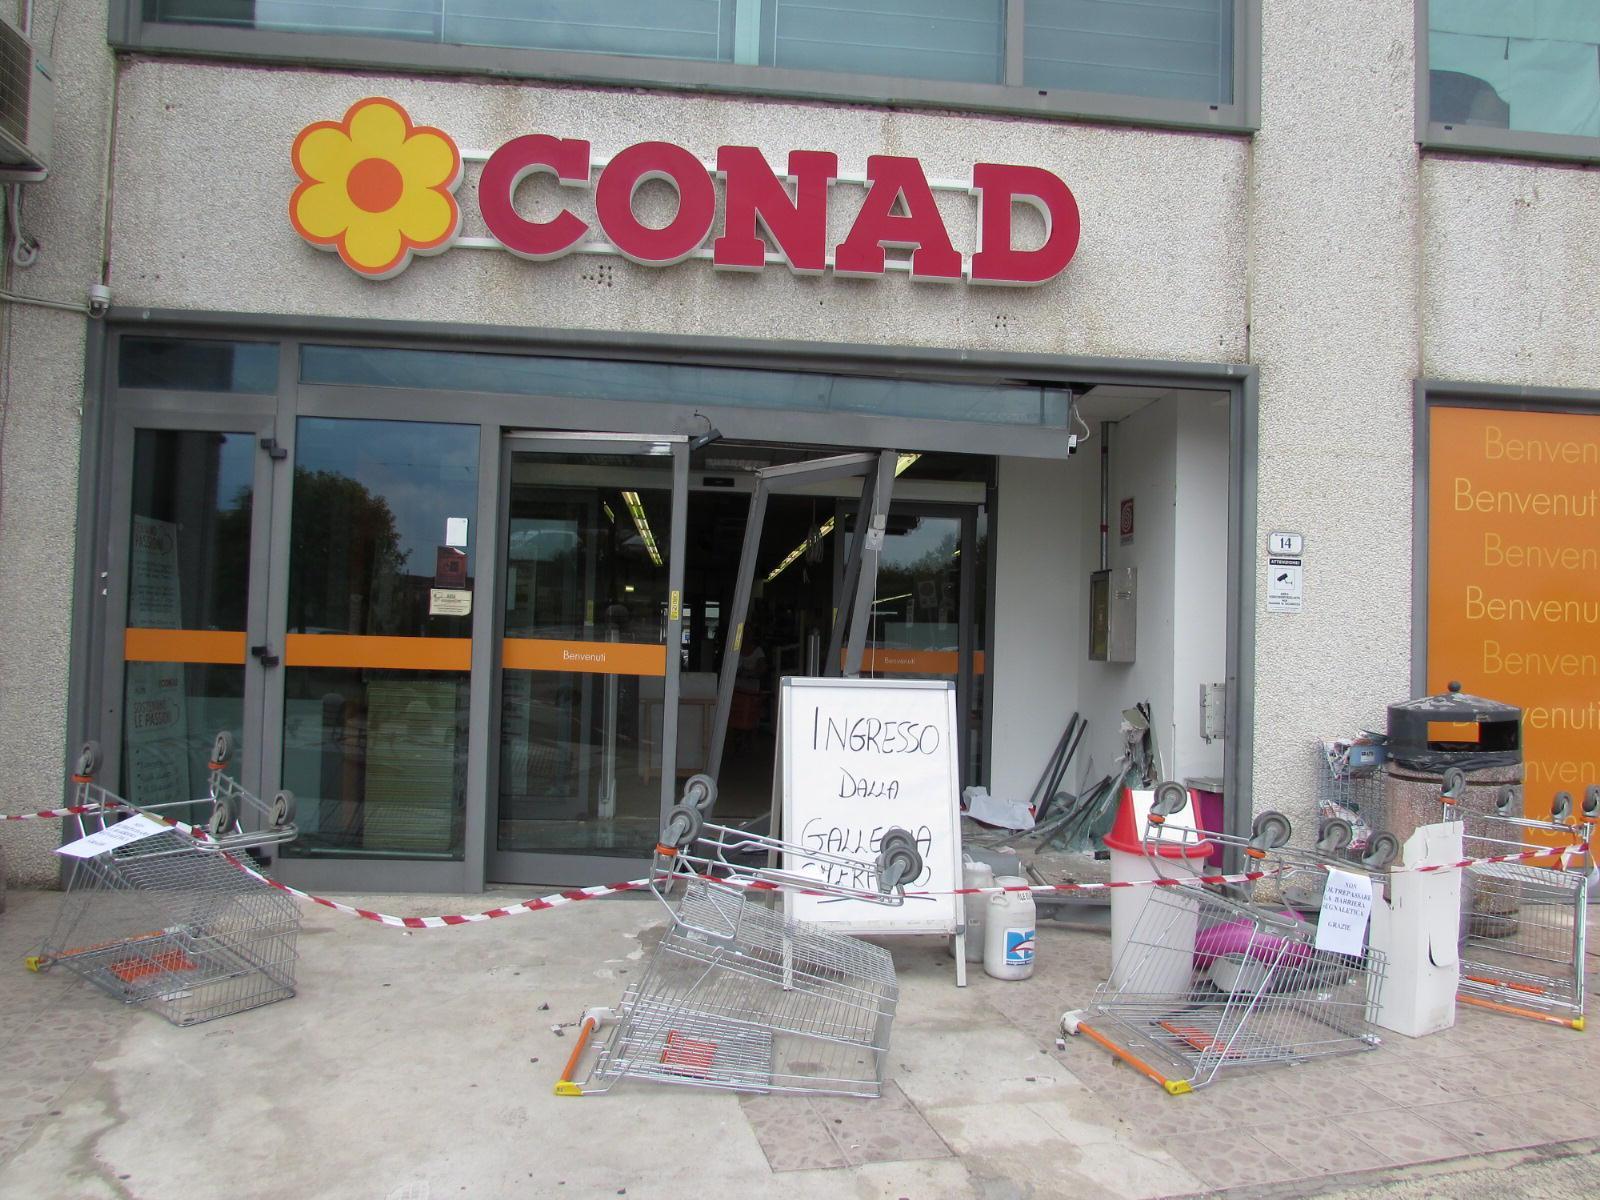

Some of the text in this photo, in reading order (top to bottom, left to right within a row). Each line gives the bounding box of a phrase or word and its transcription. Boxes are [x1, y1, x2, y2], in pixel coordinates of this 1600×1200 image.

[478, 133, 1081, 287] CONAD
[1454, 477, 1600, 517] Benvenut
[1280, 537, 1292, 549] 14
[563, 650, 606, 663] Benvenuti
[813, 706, 940, 755] INGRESSO
[838, 766, 900, 800] DALLA
[801, 817, 932, 858] GALLEA
